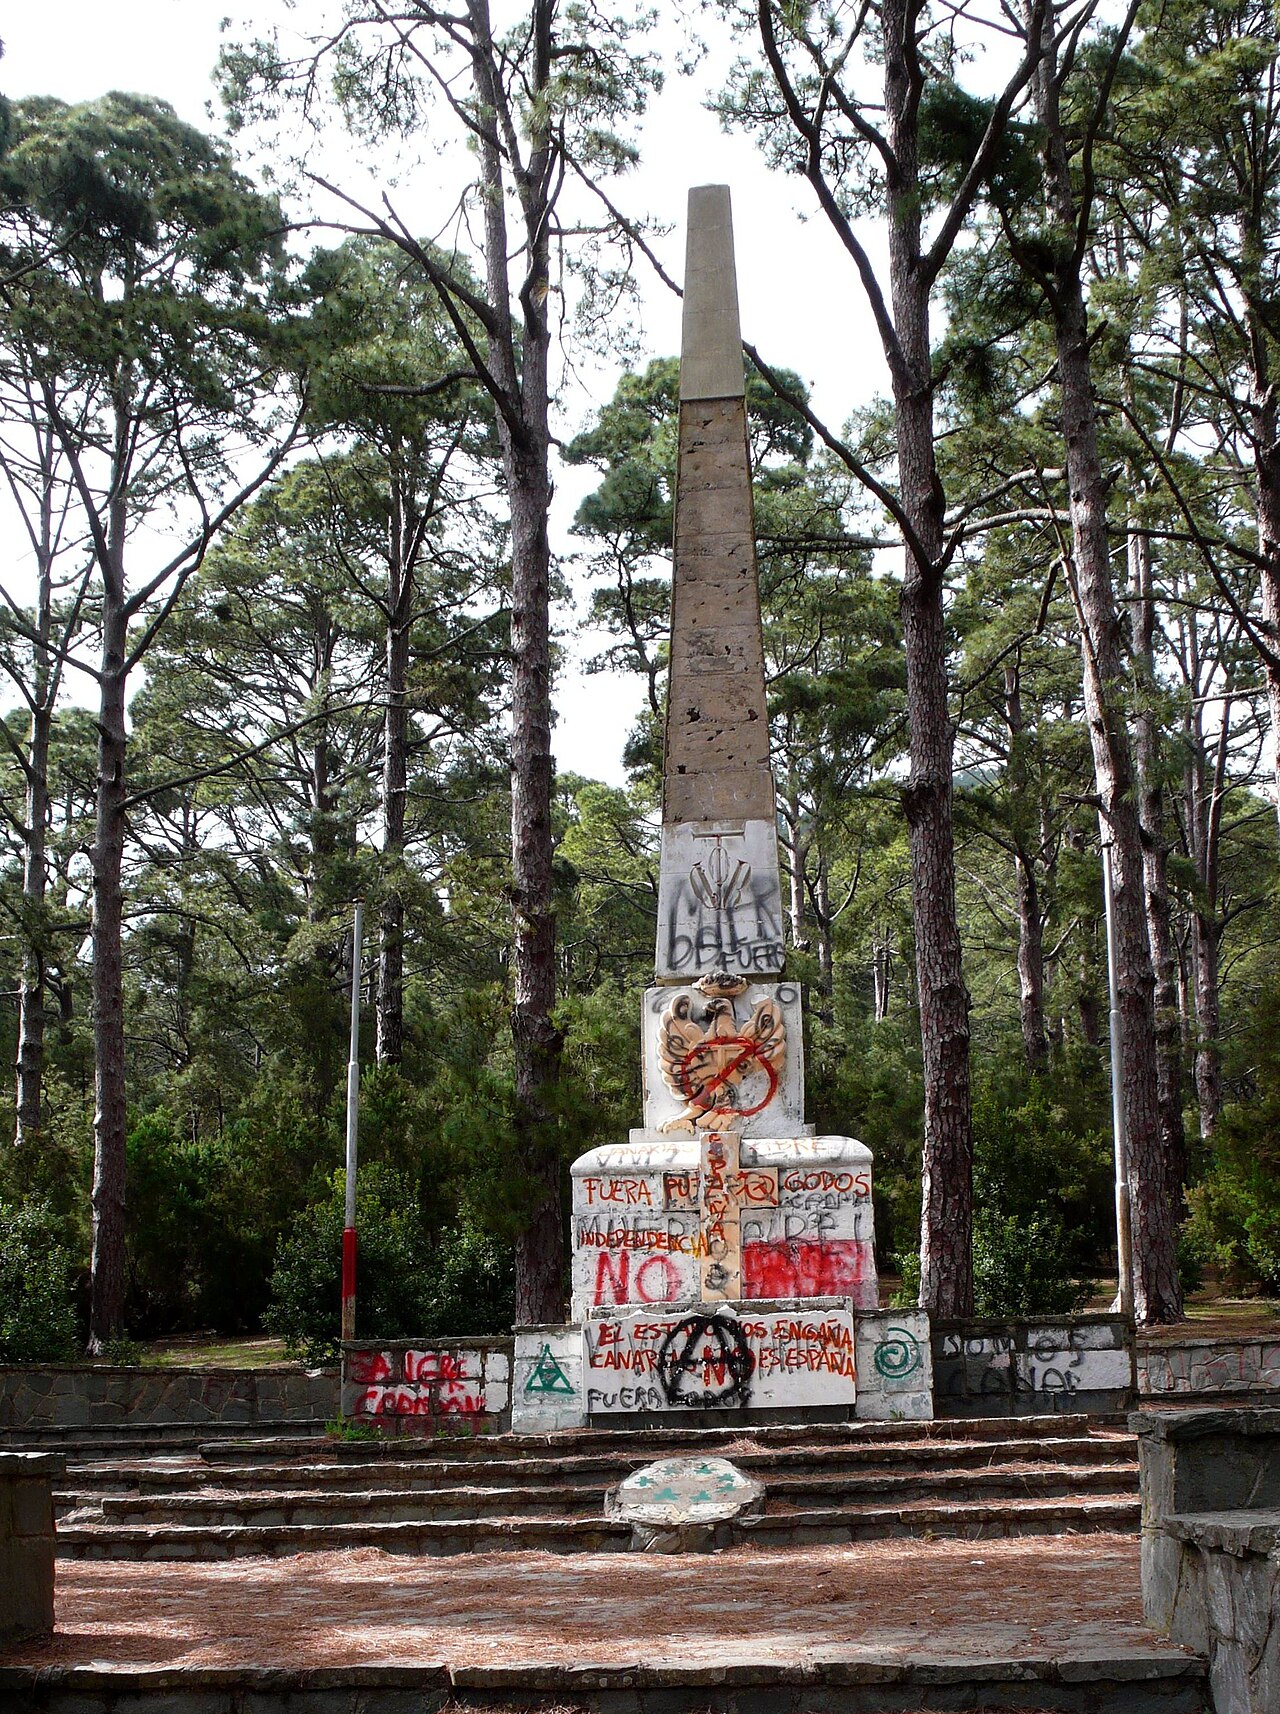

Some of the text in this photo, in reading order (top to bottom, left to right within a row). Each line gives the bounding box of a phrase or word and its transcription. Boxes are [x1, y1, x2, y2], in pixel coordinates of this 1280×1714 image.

[582, 1178, 653, 1205] FUERA
[784, 1171, 870, 1198] GODOS
[580, 1229, 710, 1258] INDEPENDENCIA
[593, 1250, 682, 1305] NO
[599, 1323, 625, 1346] EL
[758, 1348, 782, 1370] ES
[587, 1388, 662, 1413] FUERA
